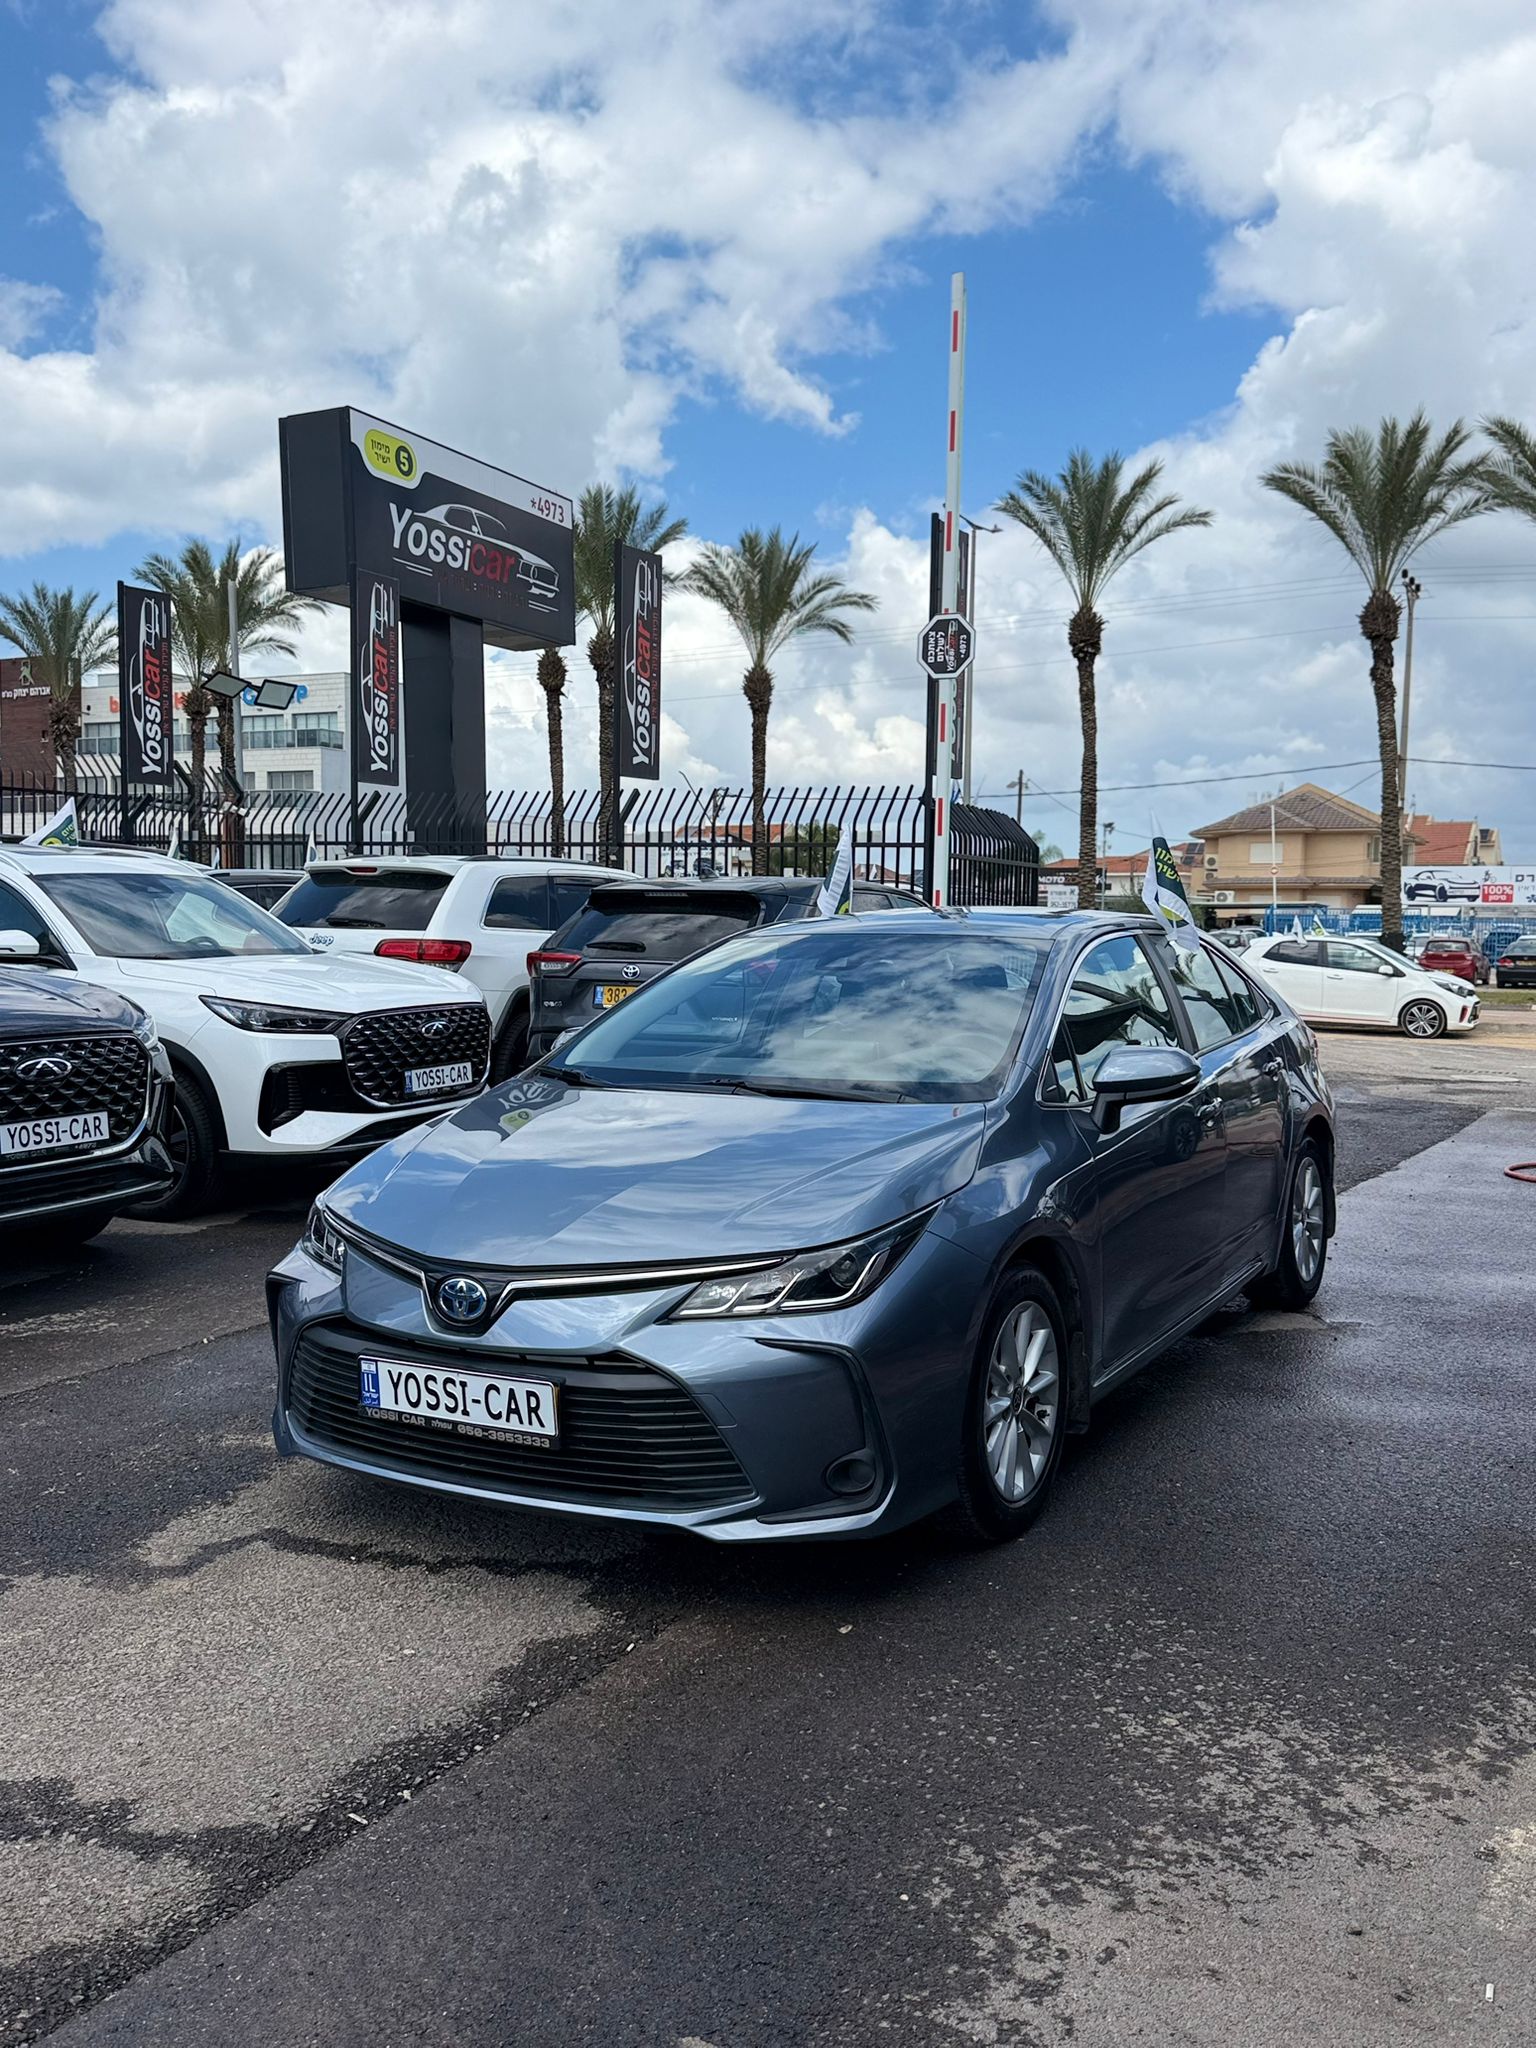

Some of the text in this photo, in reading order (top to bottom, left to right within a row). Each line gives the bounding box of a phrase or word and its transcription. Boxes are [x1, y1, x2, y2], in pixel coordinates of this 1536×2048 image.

[371, 439, 390, 454] מימון
[374, 451, 391, 464] ישיר
[399, 450, 409, 472] 5
[936, 631, 946, 662] לשלום
[1484, 885, 1513, 895] 100%
[309, 933, 335, 946] Jeep
[415, 1065, 469, 1088] YOSSI-CAR
[7, 1116, 104, 1149] YOSSI-CAR
[364, 1373, 377, 1393] IL
[388, 1369, 546, 1428] YOSSI-CAR
[365, 1407, 399, 1421] YOSSI
[402, 1414, 426, 1427] CAR
[457, 1424, 551, 1449] 050-3953333
